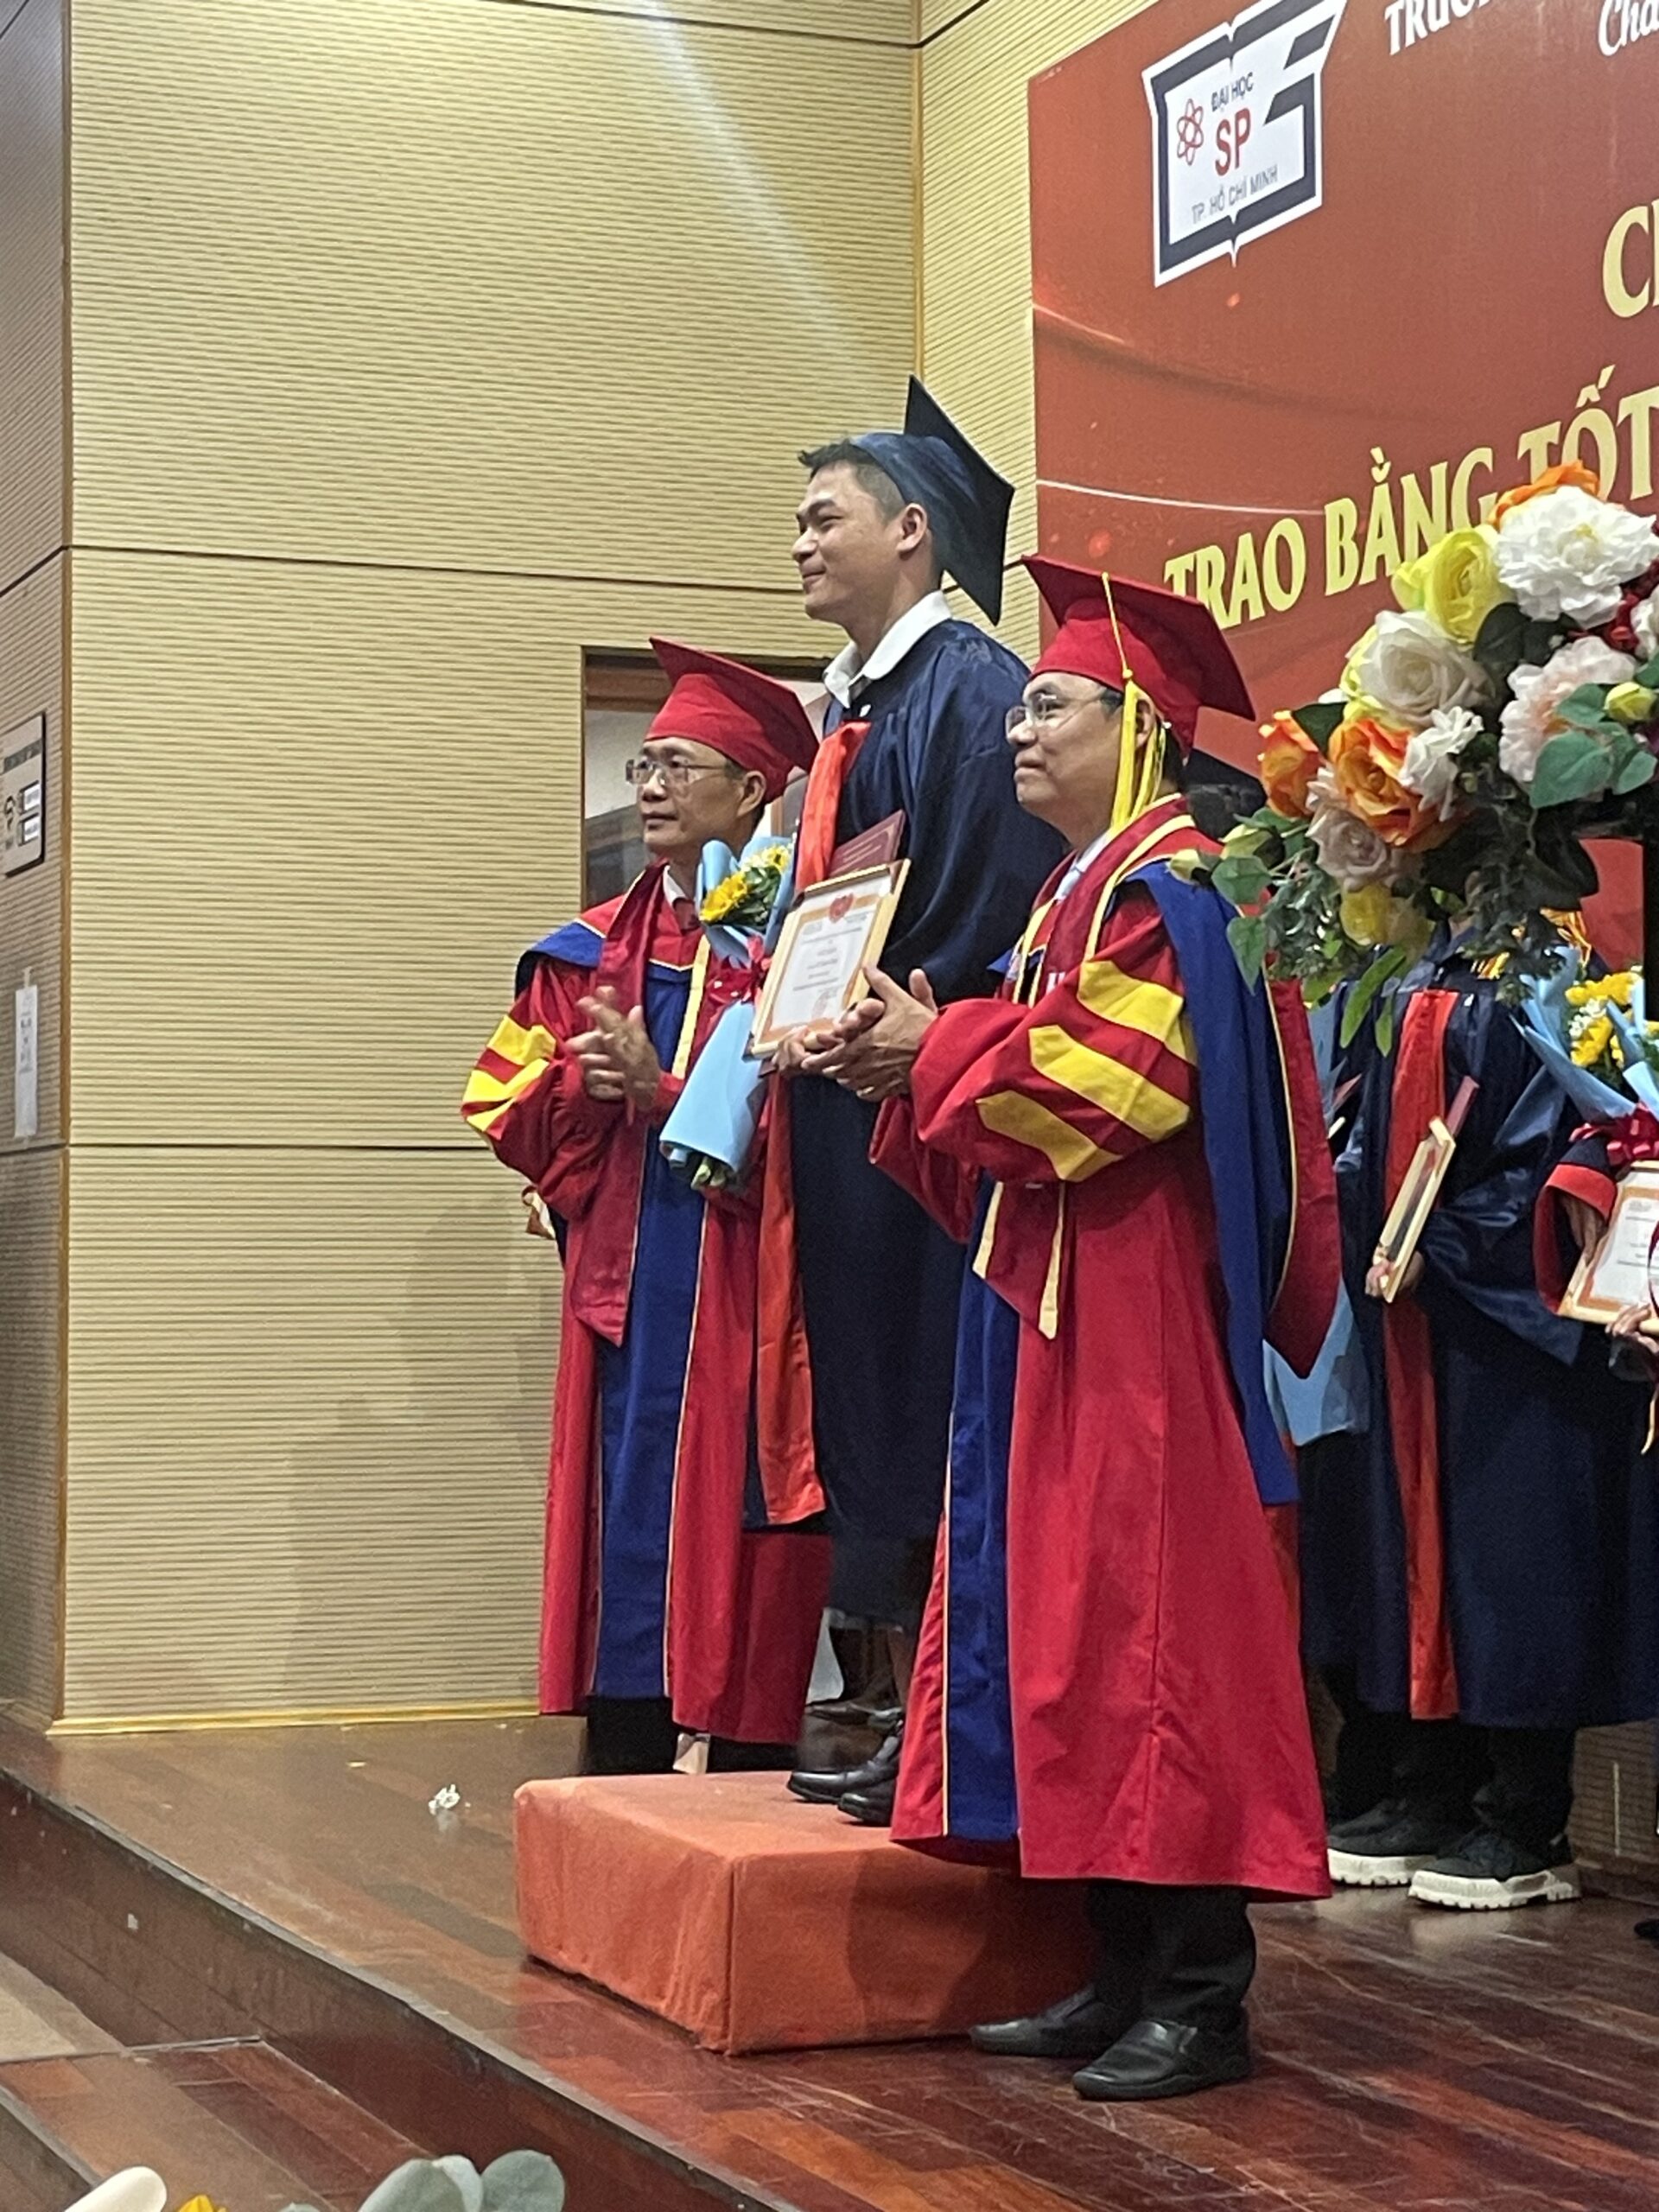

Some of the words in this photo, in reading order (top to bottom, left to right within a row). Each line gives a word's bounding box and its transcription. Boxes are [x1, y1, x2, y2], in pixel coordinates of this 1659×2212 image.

[1211, 86, 1229, 112] ĐẠI
[1231, 72, 1254, 100] HỌC
[1215, 108, 1251, 176] SP
[1250, 164, 1278, 195] MINH
[1603, 199, 1659, 318] C
[1164, 518, 1306, 629] TRAO
[1325, 447, 1498, 596] BẰNG
[1516, 364, 1659, 501] TỐT
